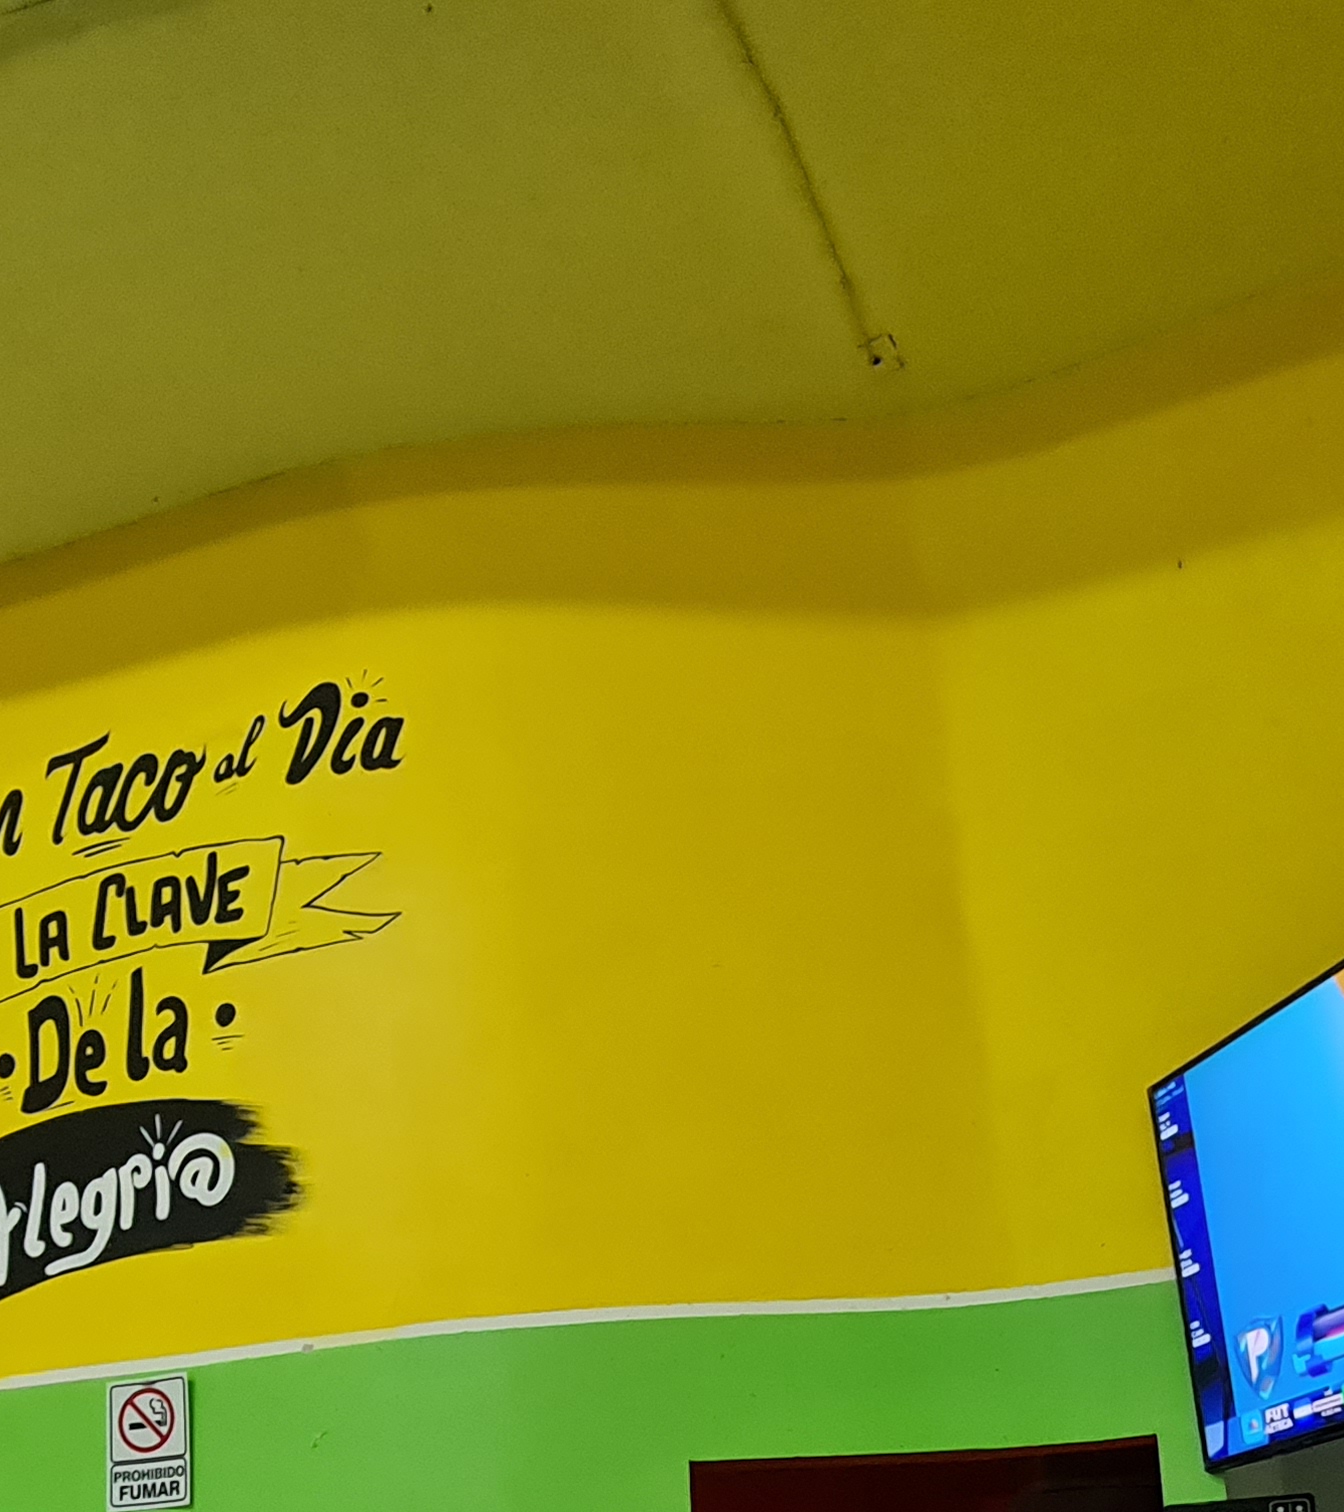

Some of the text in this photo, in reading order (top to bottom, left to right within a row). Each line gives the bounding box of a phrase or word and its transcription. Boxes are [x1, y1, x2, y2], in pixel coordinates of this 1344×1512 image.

[45, 731, 206, 845] Taco
[214, 715, 266, 784] al
[14, 907, 69, 980] LA
[92, 851, 251, 953] CLAVE
[20, 967, 189, 1115] De la
[114, 1465, 185, 1483] PROHIBIDO
[119, 1481, 180, 1501] FUMAR
